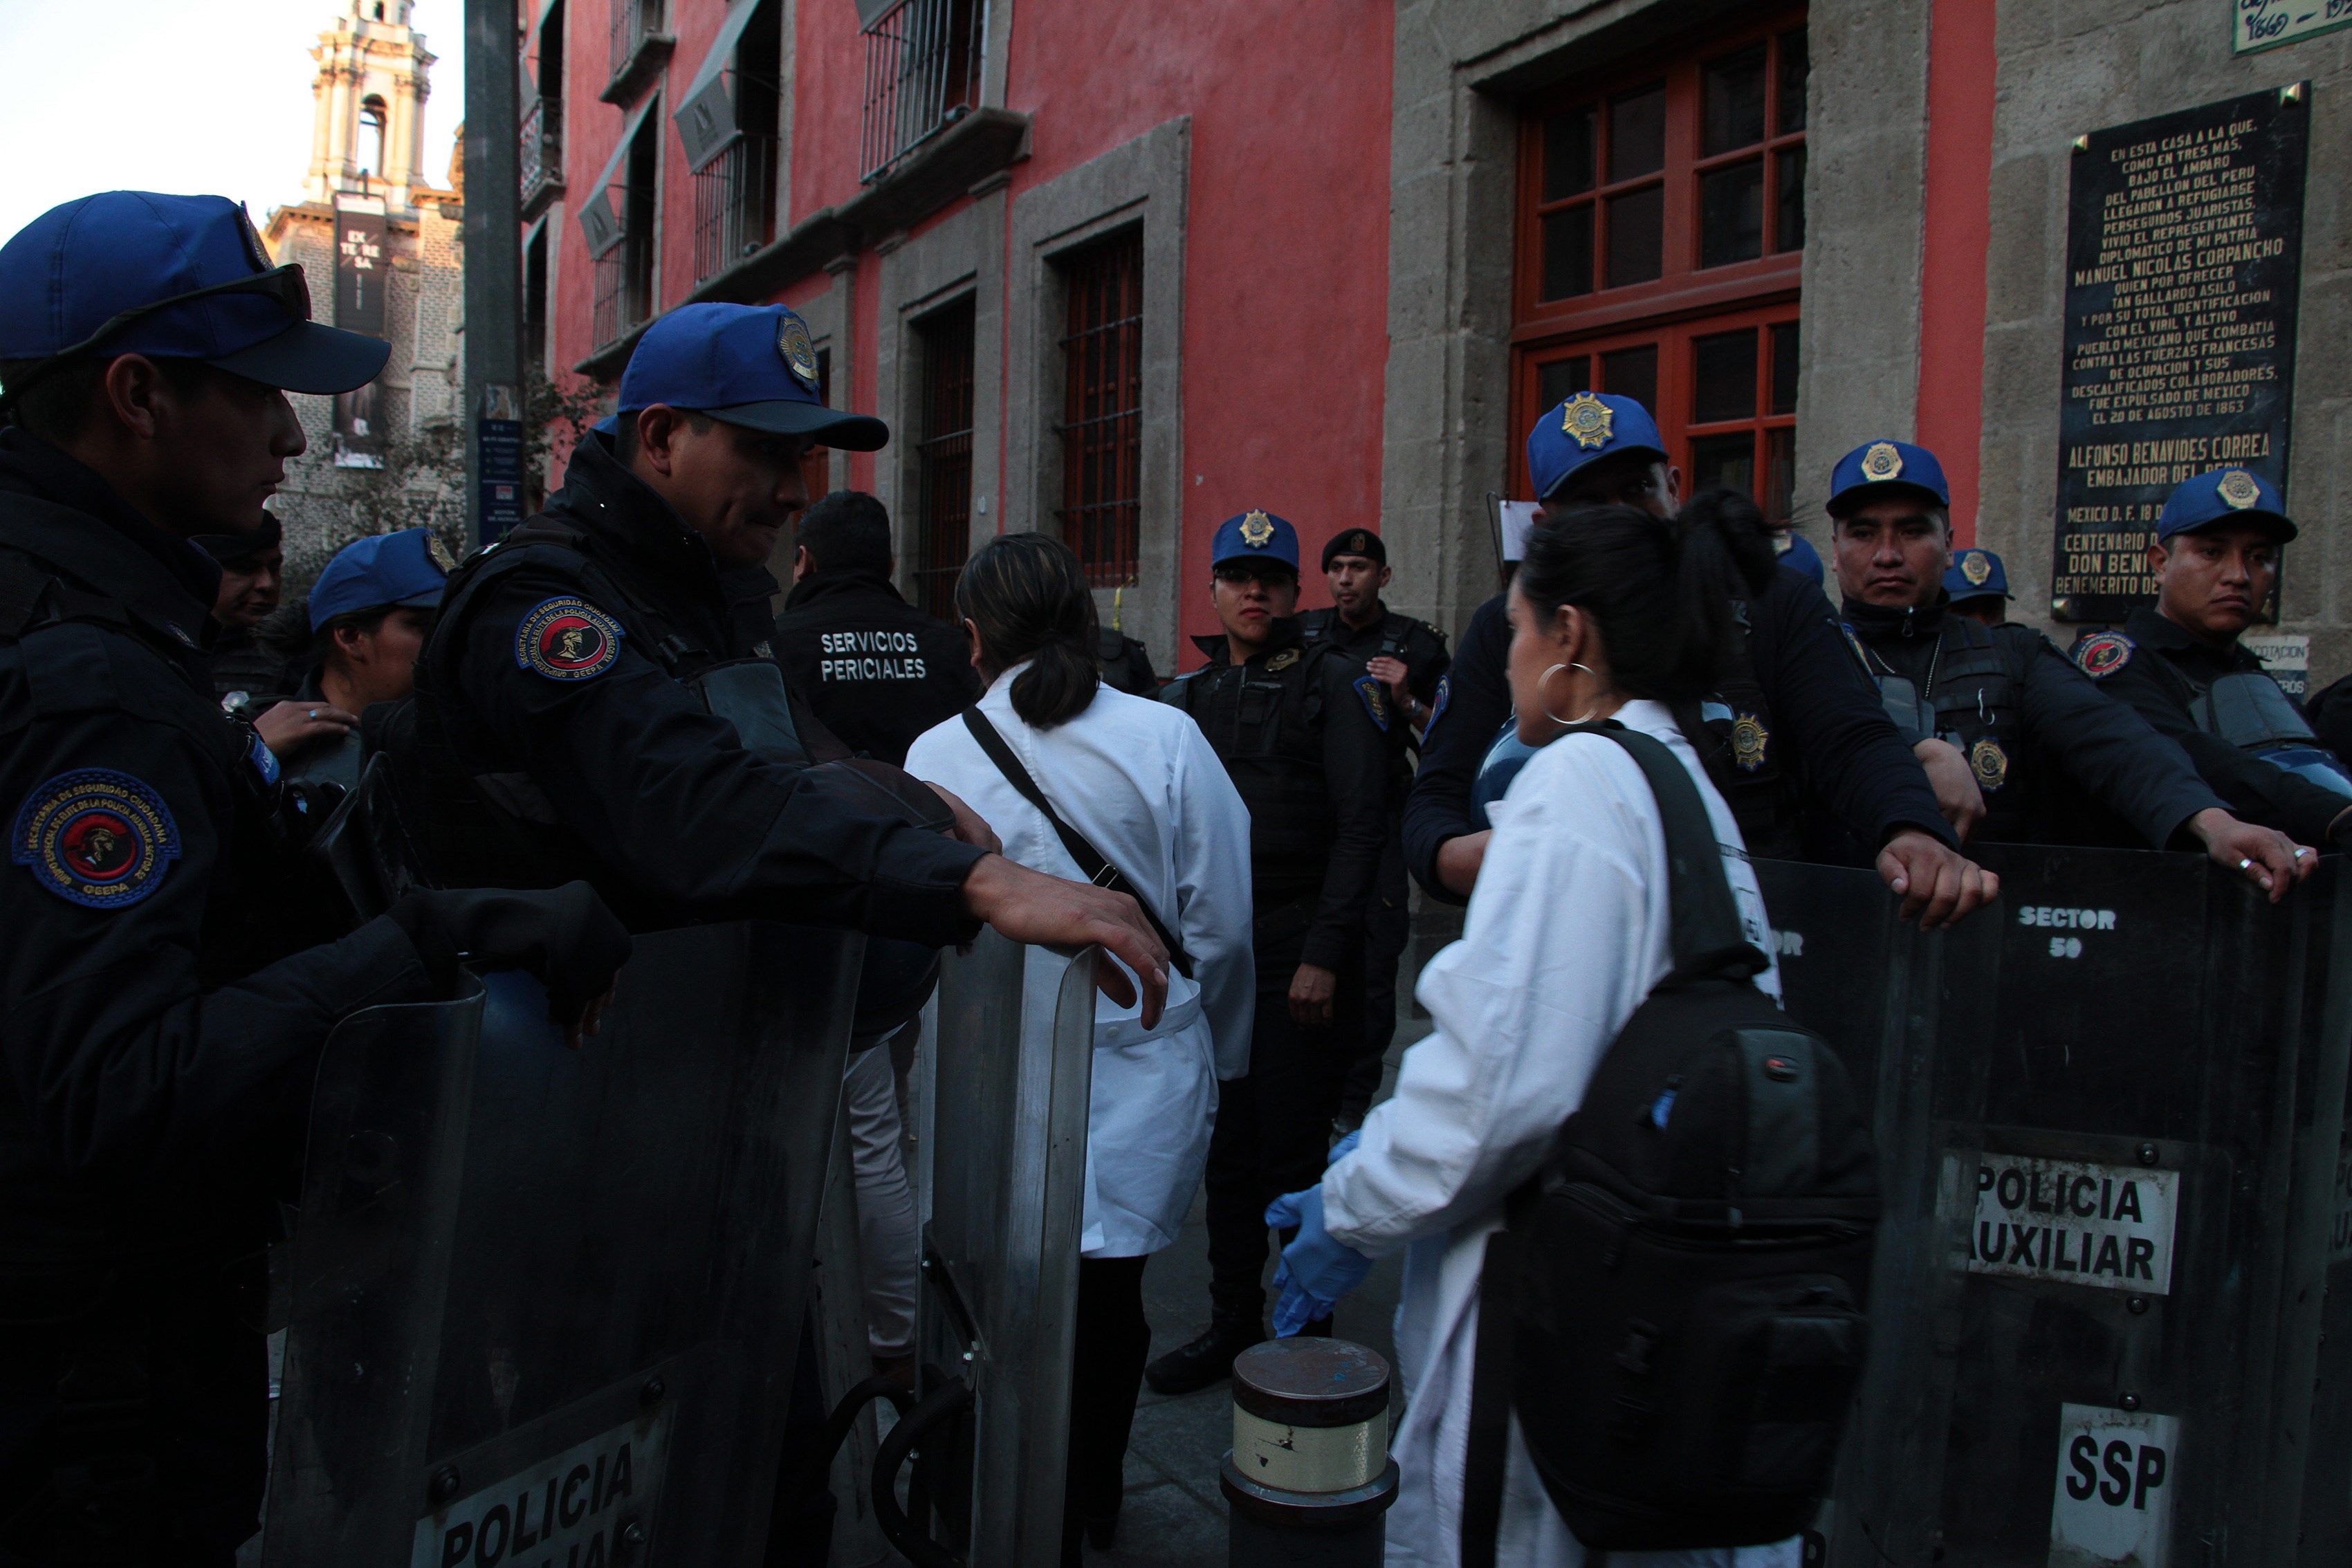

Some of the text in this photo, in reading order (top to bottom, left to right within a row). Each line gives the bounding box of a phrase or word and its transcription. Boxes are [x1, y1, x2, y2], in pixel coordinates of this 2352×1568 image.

[2111, 149, 2125, 163] EN
[2130, 141, 2156, 158] ESTA
[2162, 133, 2192, 151] CASA
[2196, 129, 2204, 143] A
[2209, 124, 2224, 140] LA
[2122, 157, 2153, 174] COMO
[2158, 152, 2172, 166] EN
[2177, 145, 2207, 162] TRES
[2129, 155, 2229, 187] BAJO EL AMPARO
[2106, 165, 2254, 207] DEL PABELLON DEL PERU
[2104, 180, 2254, 221] LLEGARON A REFUGIARSE
[347, 229, 367, 244] EX
[2102, 211, 2253, 250] VIVIO EL REPRESENTANTE
[2104, 210, 2181, 237] PERSEGUIDOS
[2100, 225, 2257, 265] DIPLOMATICO DE MI PATRIA
[353, 255, 374, 270] SA
[2075, 237, 2283, 288] MANUEL NICOLAS CORPANCHO
[2115, 266, 2232, 295] QUIEN POR OFRECER
[2081, 289, 2270, 329] Y POR SU TOTAL IDENTIFICACION
[2113, 281, 2235, 309] TAN GALLARDO ASILO
[2077, 320, 2274, 356] PUEBLO MEXICANO QUE COMBATIA
[2106, 310, 2236, 338] CON EL VIRIL Y ALTIVO
[2073, 335, 2275, 371] CONTRA LAS FUERZAS FRANCESAS
[2110, 357, 2229, 380] DE OCUPACION Y SUS
[2072, 378, 2165, 400] DESCALIFICADOS
[2090, 384, 2249, 411] FUE EXPULSADO DE MEXICO
[2093, 413, 2106, 425] EL
[2111, 412, 2124, 423] 20
[2129, 409, 2142, 422] DE
[2147, 405, 2192, 420] AGOSTO
[2196, 403, 2212, 416] DE
[2069, 433, 2270, 468] ALFONSO BENAVIDES CORREA
[2087, 467, 2167, 488] EMBAJADOR
[2068, 507, 2108, 523] MEXICO
[2111, 506, 2122, 522] D.
[2126, 505, 2136, 521] F.
[2064, 534, 2144, 551] CENTENARIO
[2069, 554, 2148, 573] DON BENI
[2056, 577, 2159, 594] BENEMERITO DE
[539, 599, 582, 614] SEGURIDAD
[820, 631, 918, 653] SERVICIOS
[820, 658, 927, 682] PERICIALES
[2019, 905, 2117, 930] SECTOR
[1976, 1165, 2143, 1224] POLICIA
[2066, 1435, 2166, 1511] SSP
[441, 1441, 633, 1568] POLICIA
